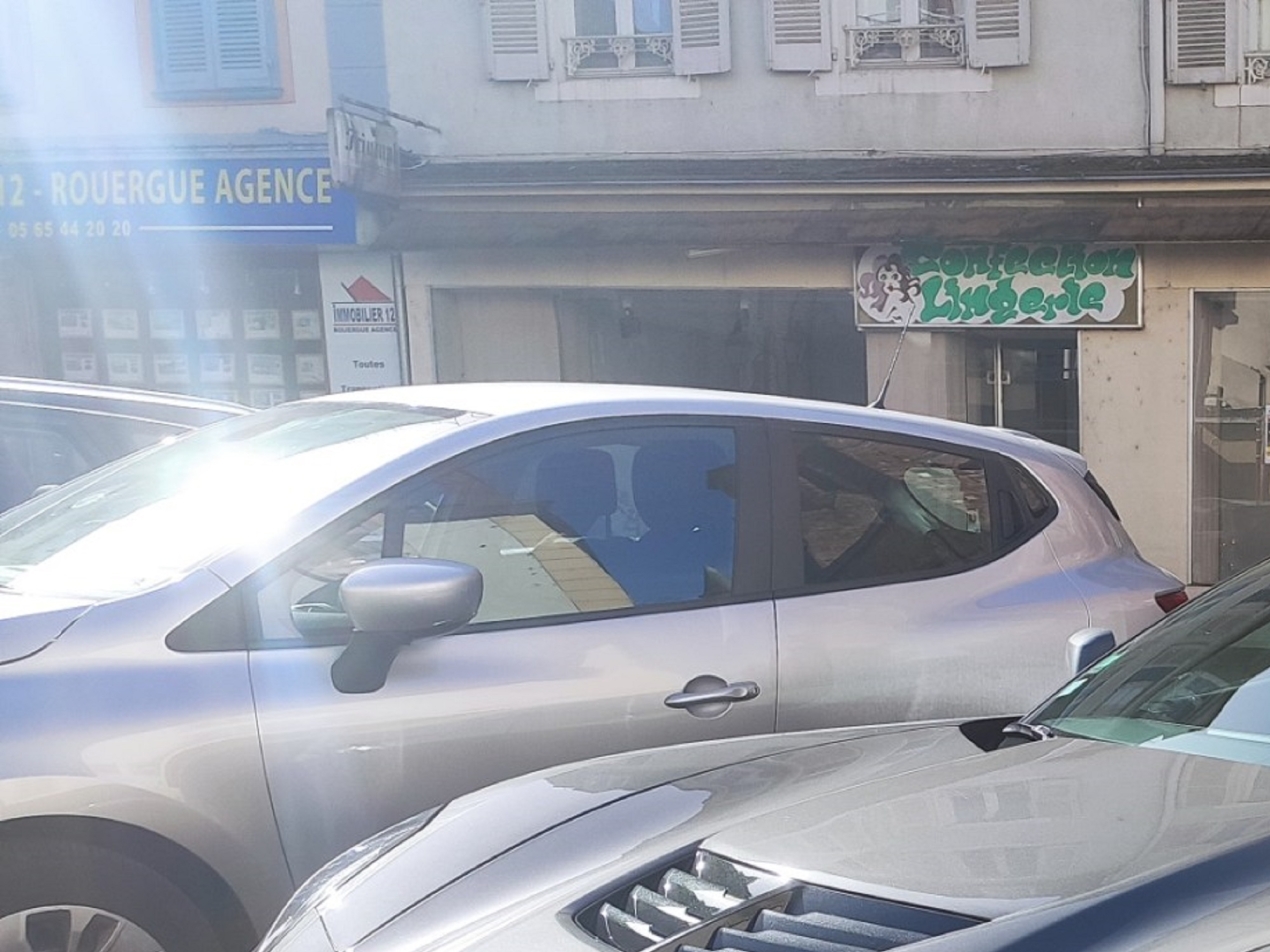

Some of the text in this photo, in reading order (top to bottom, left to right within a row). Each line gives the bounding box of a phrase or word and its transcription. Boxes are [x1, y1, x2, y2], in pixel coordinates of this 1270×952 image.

[51, 169, 205, 206] ROUERGUE
[214, 167, 333, 204] AGENCE
[86, 220, 105, 237] 20
[112, 219, 132, 237] 20
[919, 275, 1107, 325] Lingerie
[333, 304, 397, 323] IMMOBILIER 12
[352, 360, 386, 370] Toutes
